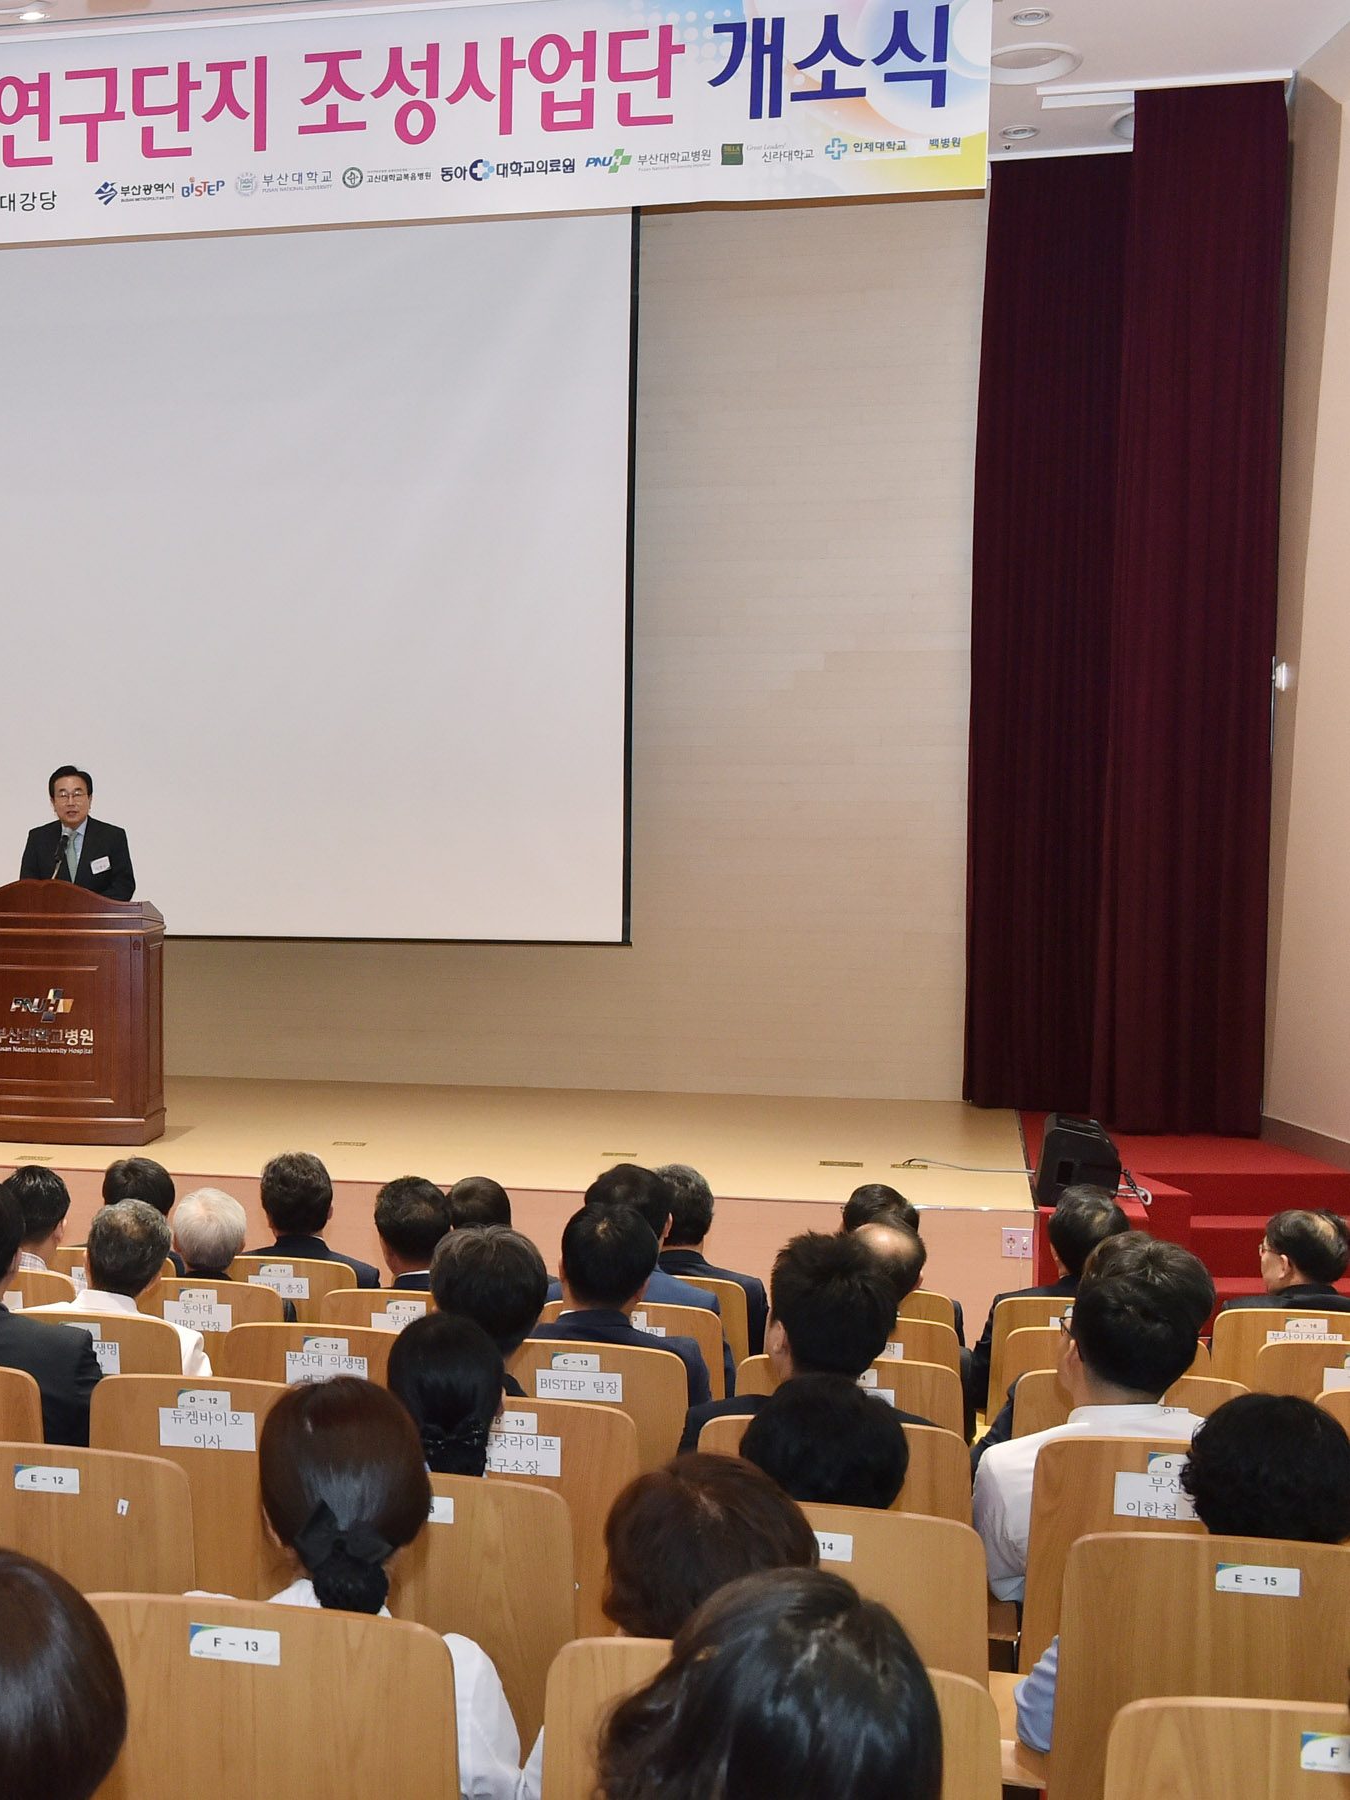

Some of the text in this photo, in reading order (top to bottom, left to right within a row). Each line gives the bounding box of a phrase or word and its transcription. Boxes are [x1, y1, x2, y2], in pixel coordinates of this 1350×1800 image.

[299, 26, 684, 144] 조성사업단
[711, 5, 949, 118] 개소식
[853, 137, 961, 152] 인제대학교 백병원
[637, 149, 712, 166] 부산대학교병원
[762, 149, 814, 163] 신라대학교
[367, 171, 432, 183] 고신대학교복음병원
[441, 158, 576, 182] 동아 대학교의료원
[262, 170, 333, 187] 부산대학교
[121, 182, 175, 196] 부산광역시
[0, 190, 58, 213] 대강당
[182, 1303, 213, 1314] 동아대
[288, 1353, 366, 1370] 부산대 의생명
[540, 1378, 618, 1395] BISTEP 팀장
[171, 1410, 243, 1427] 듀켐바이오
[193, 1434, 222, 1449] 이사
[30, 1474, 37, 1482] E
[53, 1476, 64, 1484] 12
[1126, 1501, 1177, 1520] 이한철
[822, 1542, 834, 1551] 14
[1234, 1574, 1242, 1584] E
[1263, 1576, 1278, 1586] 15
[214, 1638, 222, 1648] F
[244, 1640, 258, 1652] 13
[1330, 1747, 1340, 1758] F
